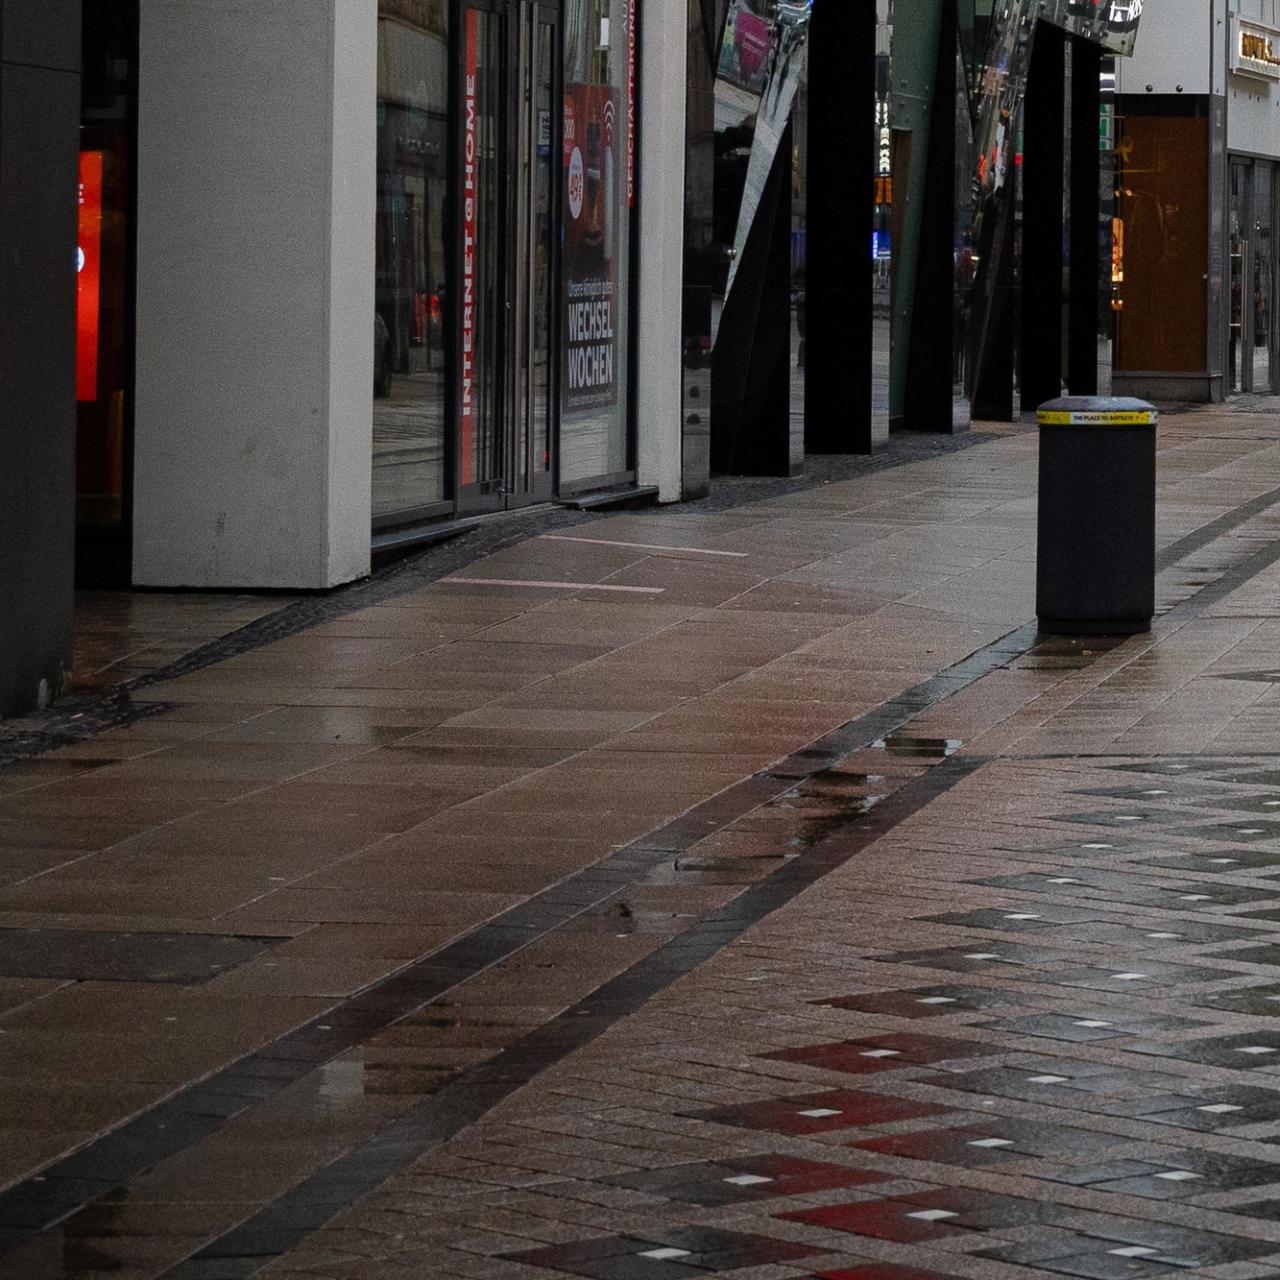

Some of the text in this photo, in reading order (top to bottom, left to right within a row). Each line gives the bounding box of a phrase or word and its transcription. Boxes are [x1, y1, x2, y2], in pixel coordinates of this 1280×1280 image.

[465, 74, 476, 190] HOME
[462, 230, 474, 417] INTERNET
[568, 302, 613, 341] WECHSEL
[568, 345, 613, 389] WOCHEN
